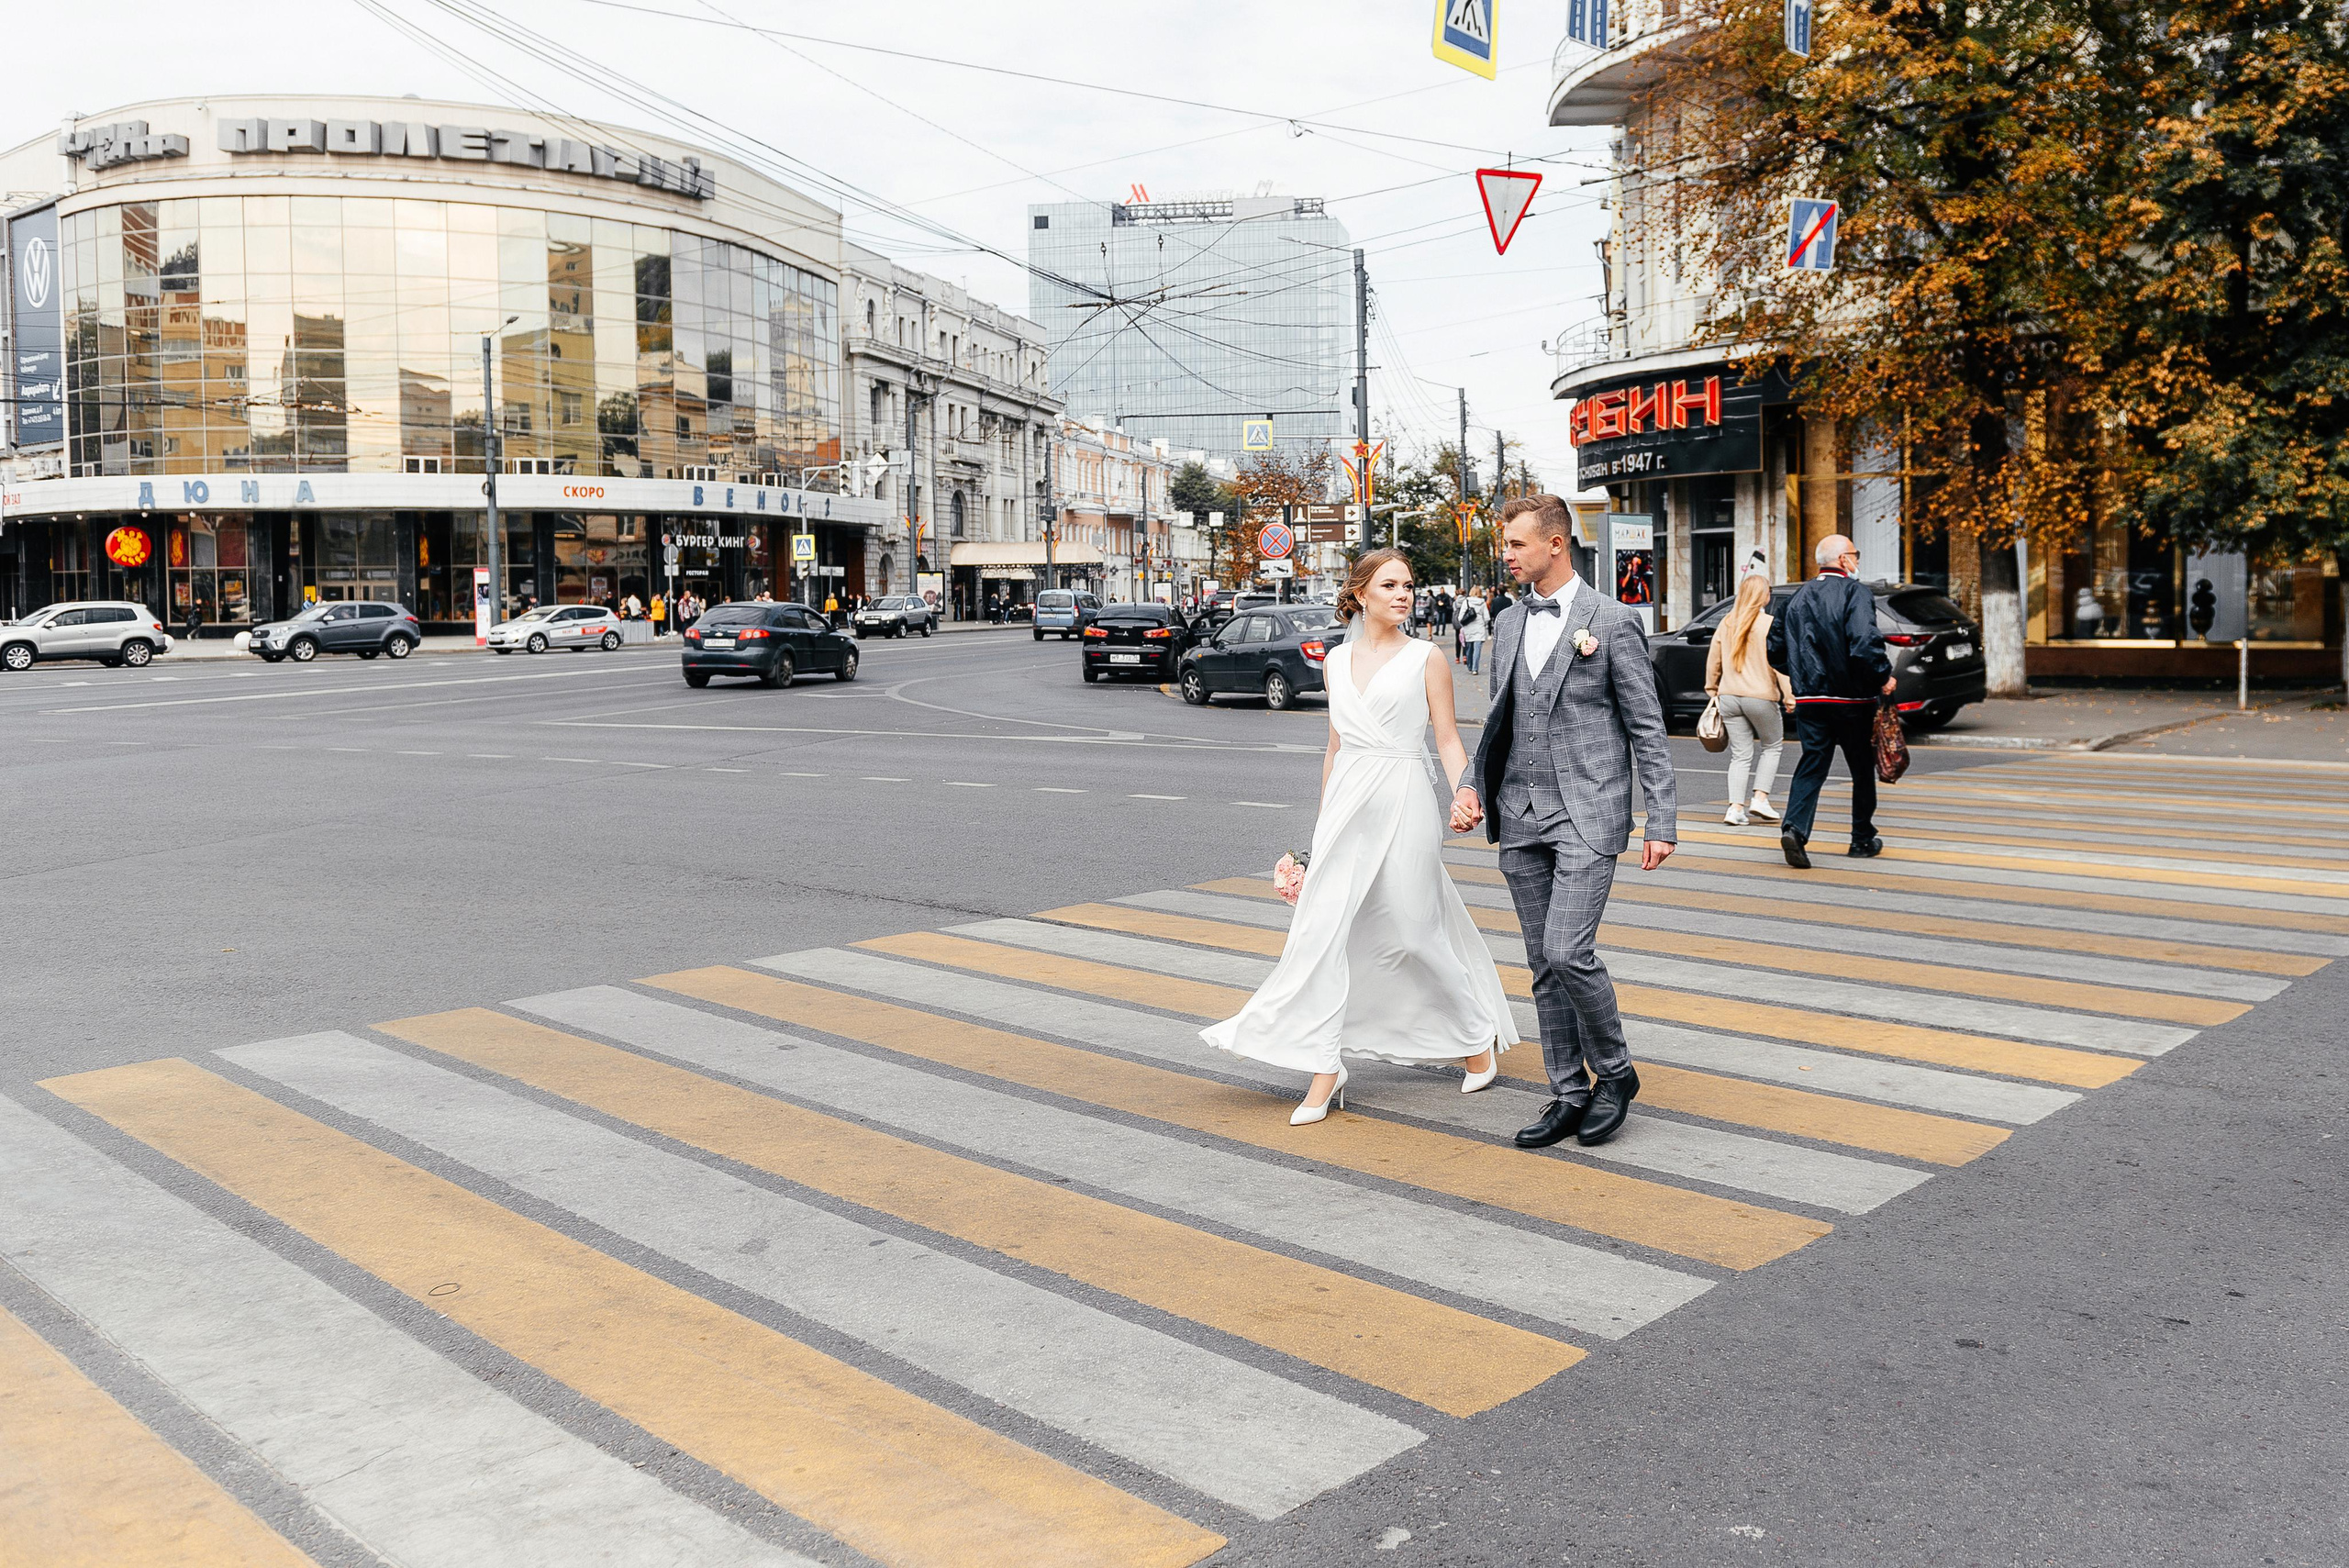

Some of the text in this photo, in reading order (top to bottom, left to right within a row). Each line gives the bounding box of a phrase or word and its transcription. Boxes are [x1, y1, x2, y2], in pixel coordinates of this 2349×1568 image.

[217, 117, 715, 200] ПРОЛЕТАРИЙ
[1156, 189, 1233, 203] MARRIOTT
[1620, 451, 1653, 473] 1947
[1656, 455, 1665, 470] г.
[139, 480, 315, 510] ДЮНА
[563, 485, 605, 498] СКОРО
[675, 534, 714, 548] БУРГЕР
[718, 536, 745, 549] КИНГ
